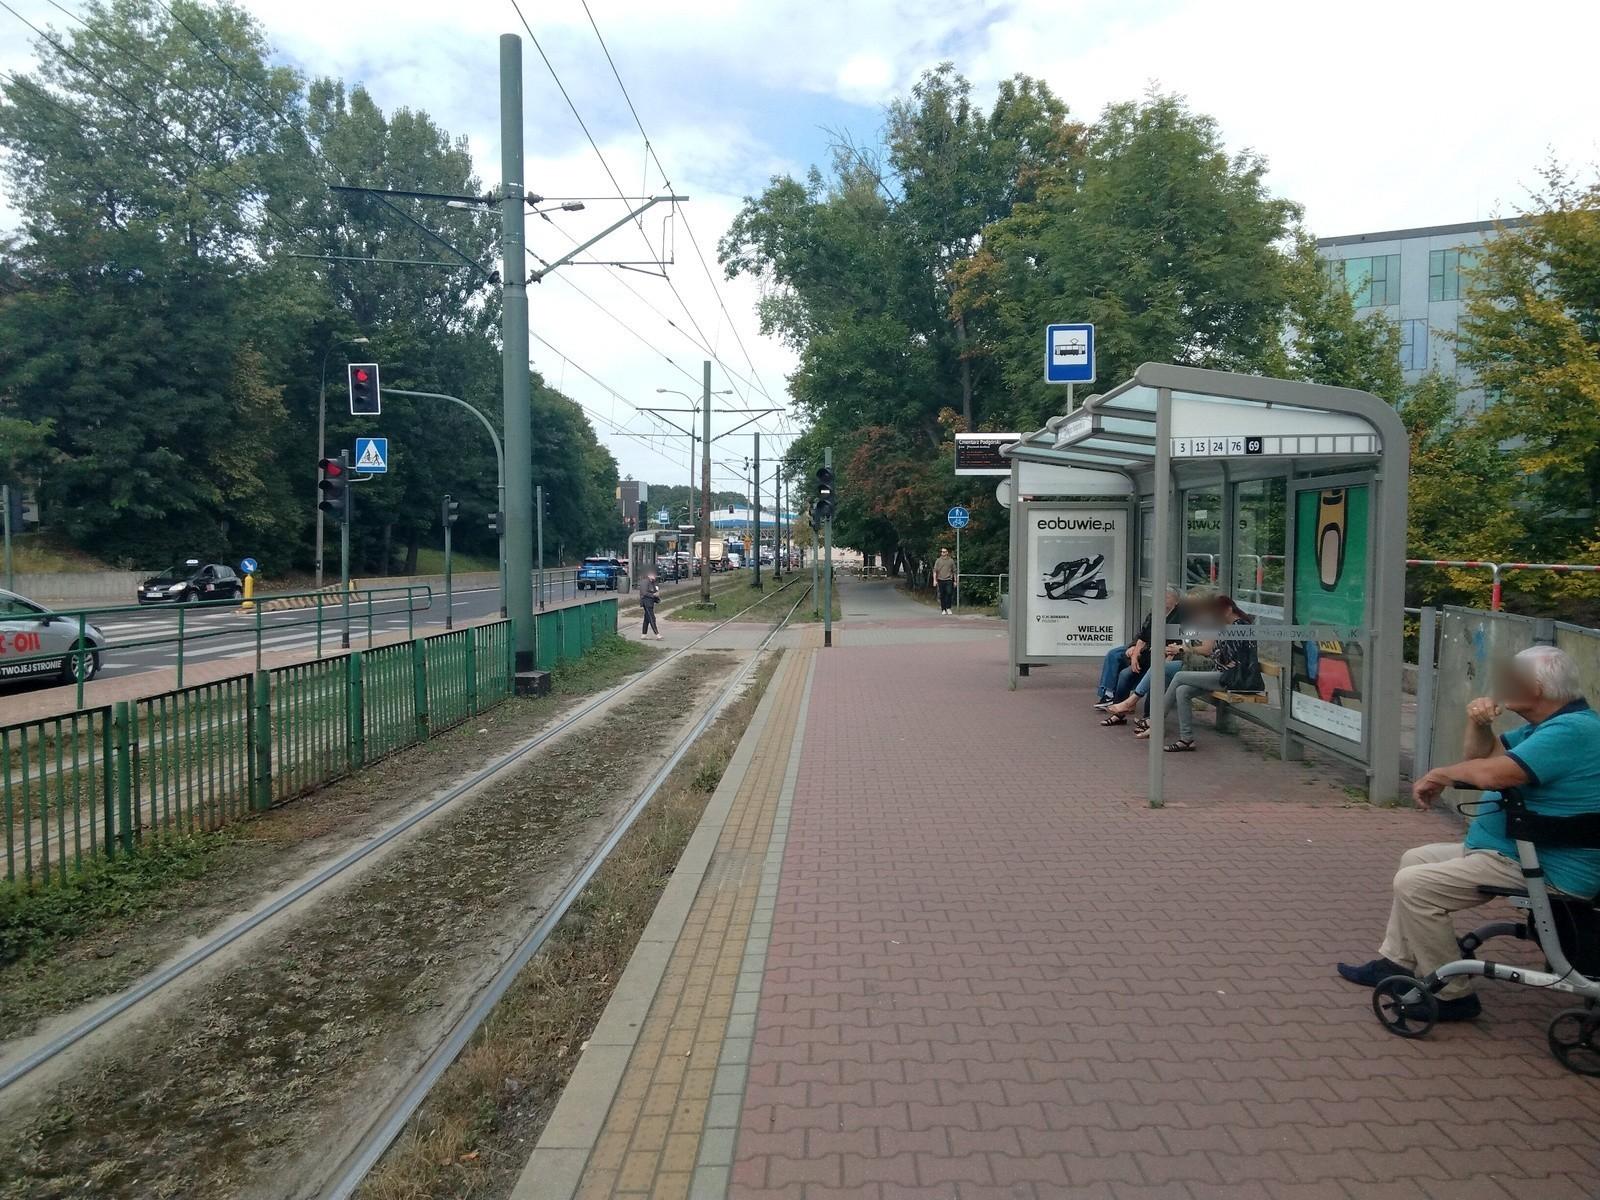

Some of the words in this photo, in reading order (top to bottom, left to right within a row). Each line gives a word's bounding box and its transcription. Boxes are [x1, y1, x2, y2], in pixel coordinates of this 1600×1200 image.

[1180, 443, 1185, 452] 3
[1196, 442, 1205, 452] 13
[1213, 442, 1223, 452] 24
[1232, 441, 1241, 451] 76
[1248, 440, 1260, 451] 69
[1037, 516, 1115, 532] eobuwie.pl
[1078, 625, 1114, 633] WIELKIE
[1066, 634, 1113, 642] OTWARCIE
[1, 664, 32, 676] TWOJEJ
[33, 660, 62, 671] STRONIE
